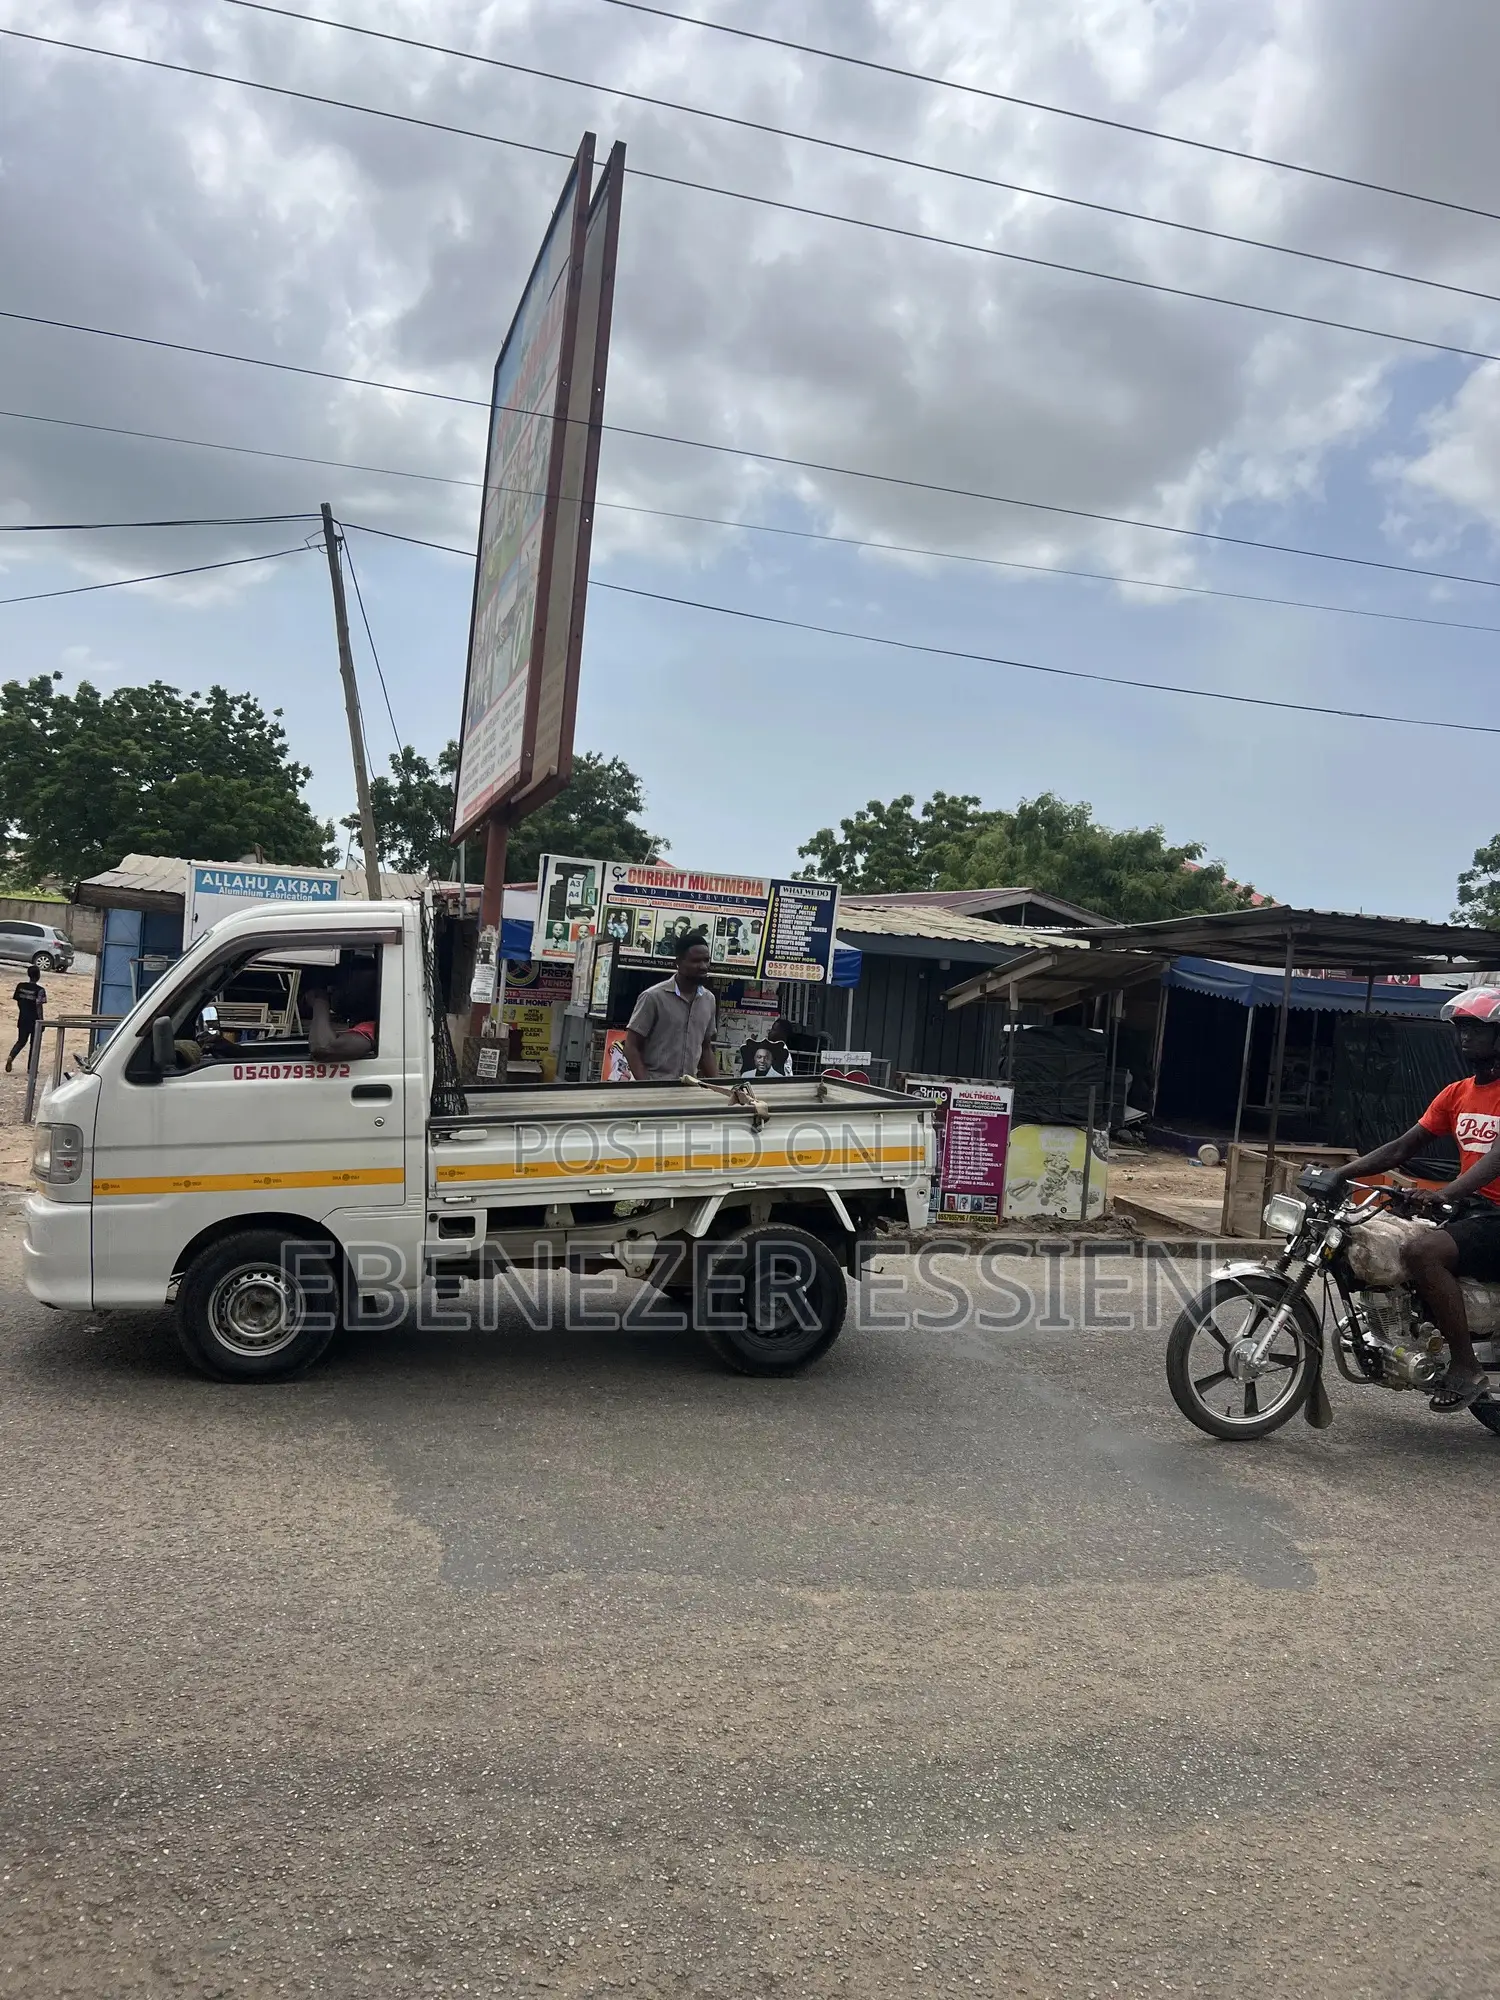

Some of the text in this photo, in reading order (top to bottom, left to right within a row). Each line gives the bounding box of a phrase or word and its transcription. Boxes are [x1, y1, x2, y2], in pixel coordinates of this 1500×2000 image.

[201, 872, 332, 895] ALLAHU AKBAR
[628, 867, 764, 897] CURRENT MULTIMEDIA
[218, 886, 313, 902] Aluminium Fabrication
[634, 887, 657, 895] AND
[690, 893, 749, 904] SERVICES
[233, 1063, 351, 1080] 0540793972
[920, 1086, 948, 1102] Bring
[959, 1092, 1001, 1102] MULTIMEDIA
